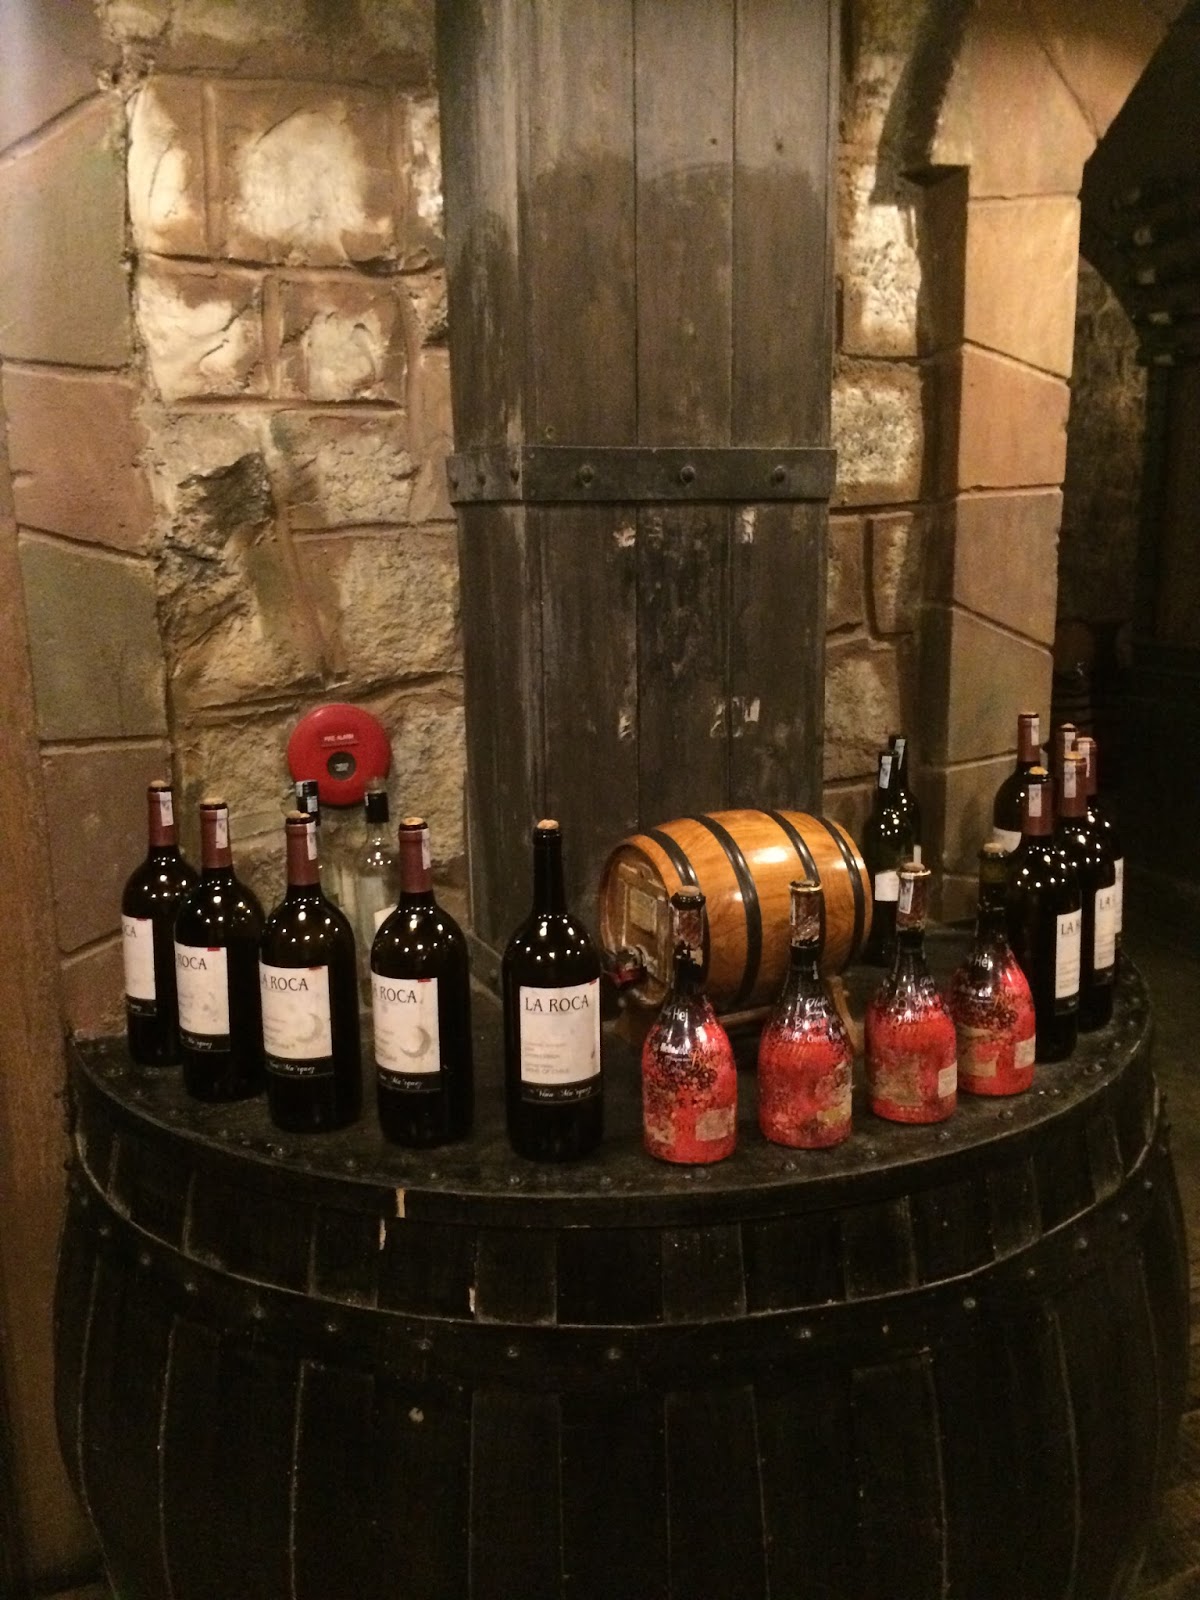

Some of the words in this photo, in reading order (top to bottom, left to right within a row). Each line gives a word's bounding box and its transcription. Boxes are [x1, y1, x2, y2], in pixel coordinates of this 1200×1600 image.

[1061, 921, 1074, 936] LA
[270, 975, 309, 992] ROCA
[380, 986, 417, 1004] ROCA
[525, 996, 543, 1012] LA
[549, 994, 589, 1013] ROCA
